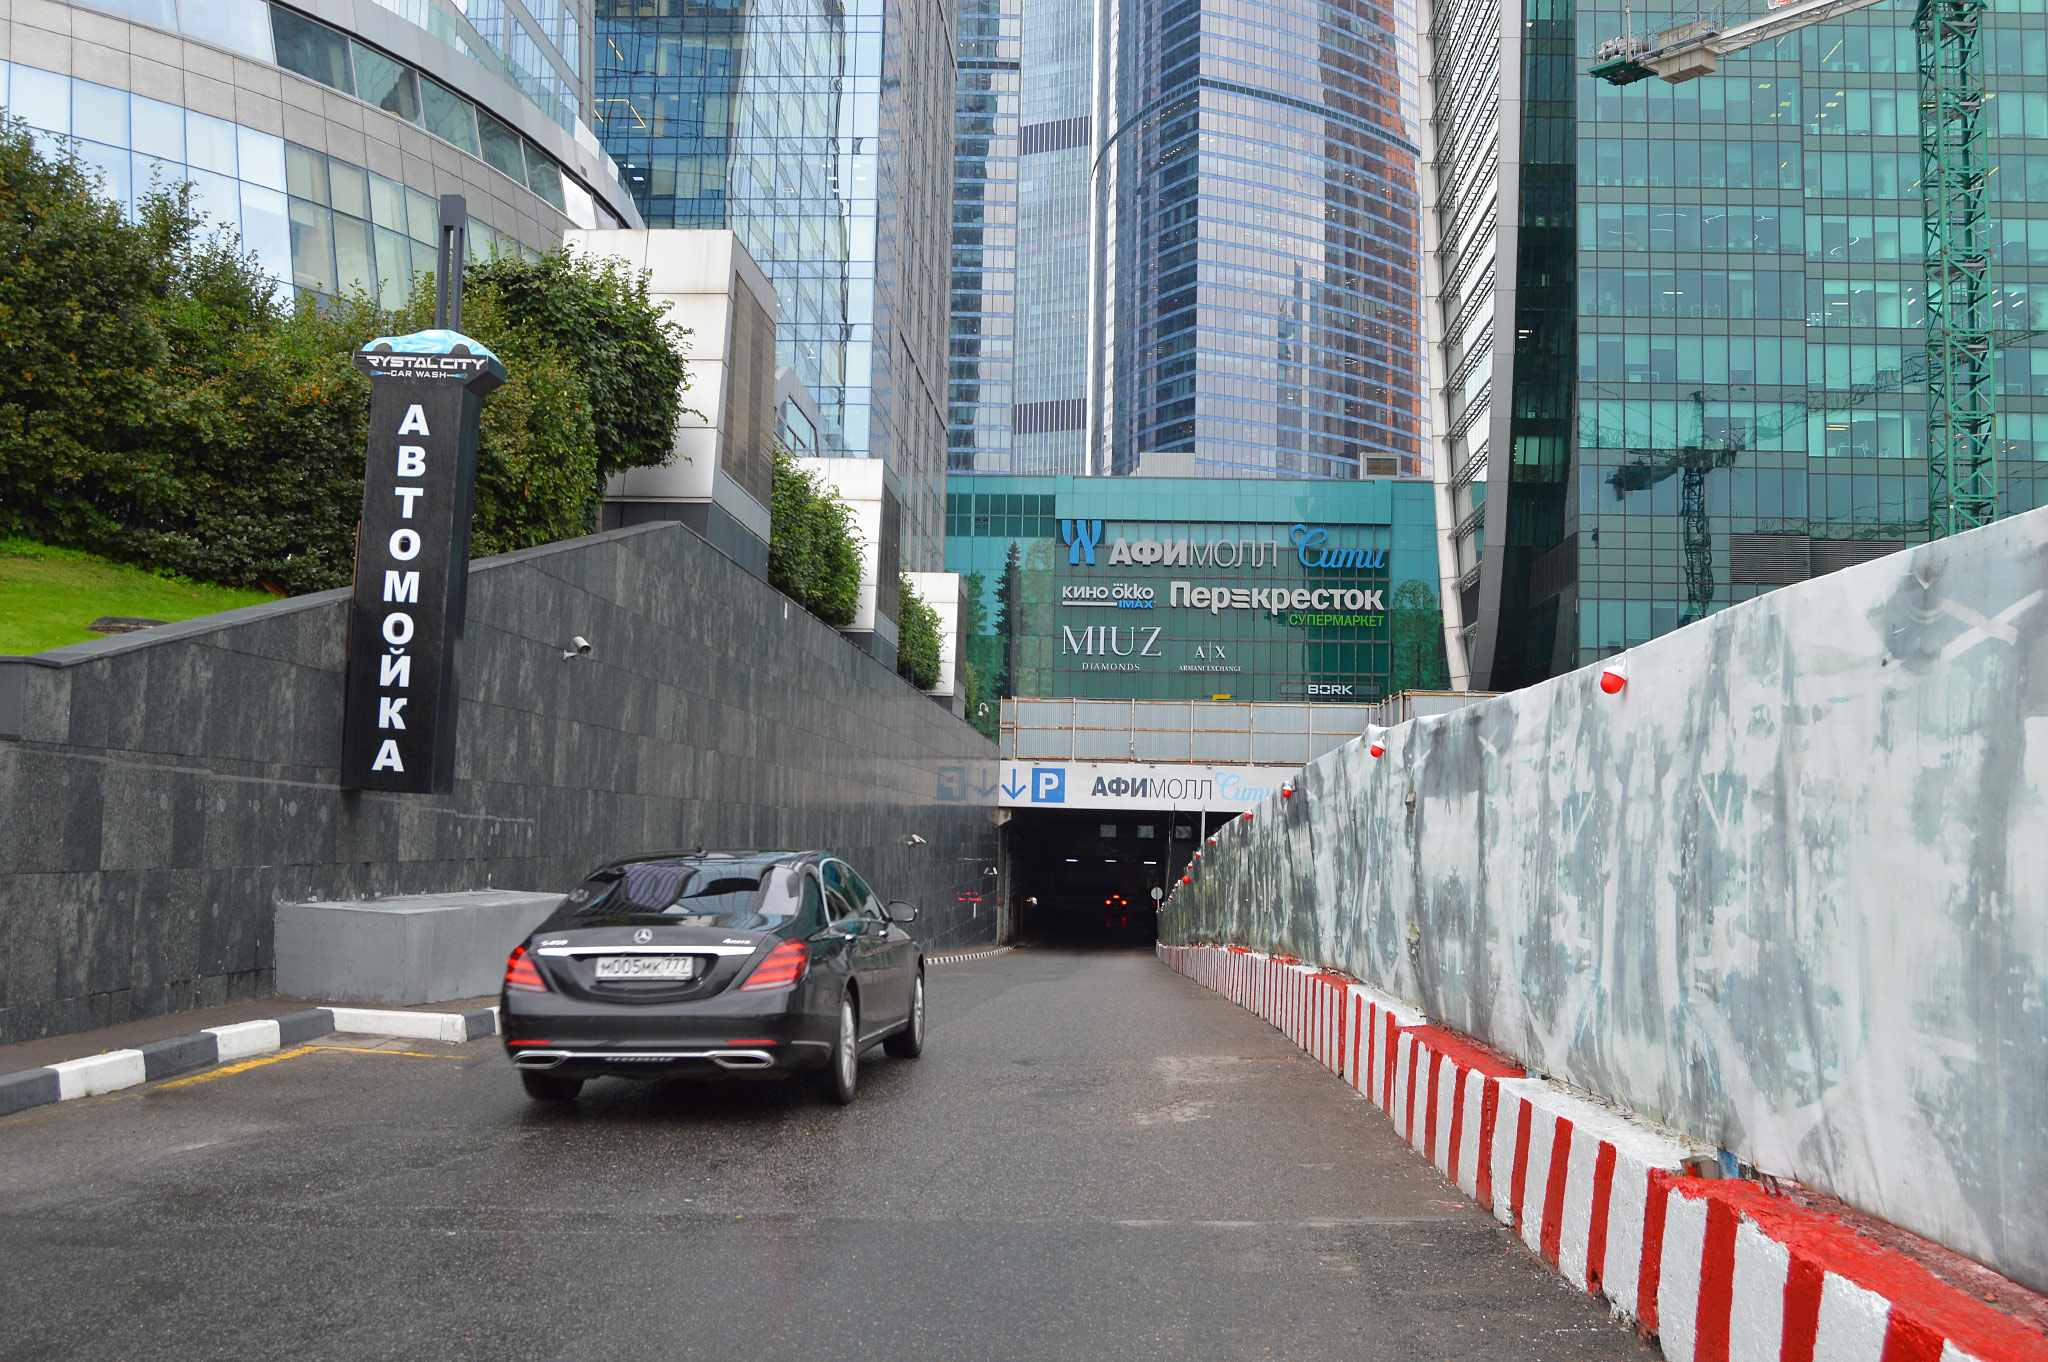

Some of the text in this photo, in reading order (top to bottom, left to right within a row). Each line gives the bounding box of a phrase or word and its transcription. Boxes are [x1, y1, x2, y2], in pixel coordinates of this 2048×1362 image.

[440, 357, 487, 371] CITY
[390, 369, 447, 379] CAR WASH
[1108, 523, 1386, 569] АФИМОЛЛ Сити
[371, 403, 430, 773] АВТОМОЙКА
[1118, 600, 1154, 609] IMAX
[1170, 580, 1385, 616] Перекресток
[1289, 614, 1385, 628] СУПЕРМАРКЕТ
[1062, 625, 1162, 658] MIUZ
[1082, 662, 1141, 672] DIAMONDS
[1207, 665, 1243, 673] EXCHANGE
[1307, 684, 1353, 695] BORK
[1040, 772, 1060, 798] P
[1090, 775, 1213, 800] АФИМОЛЛ
[665, 957, 689, 970] 777
